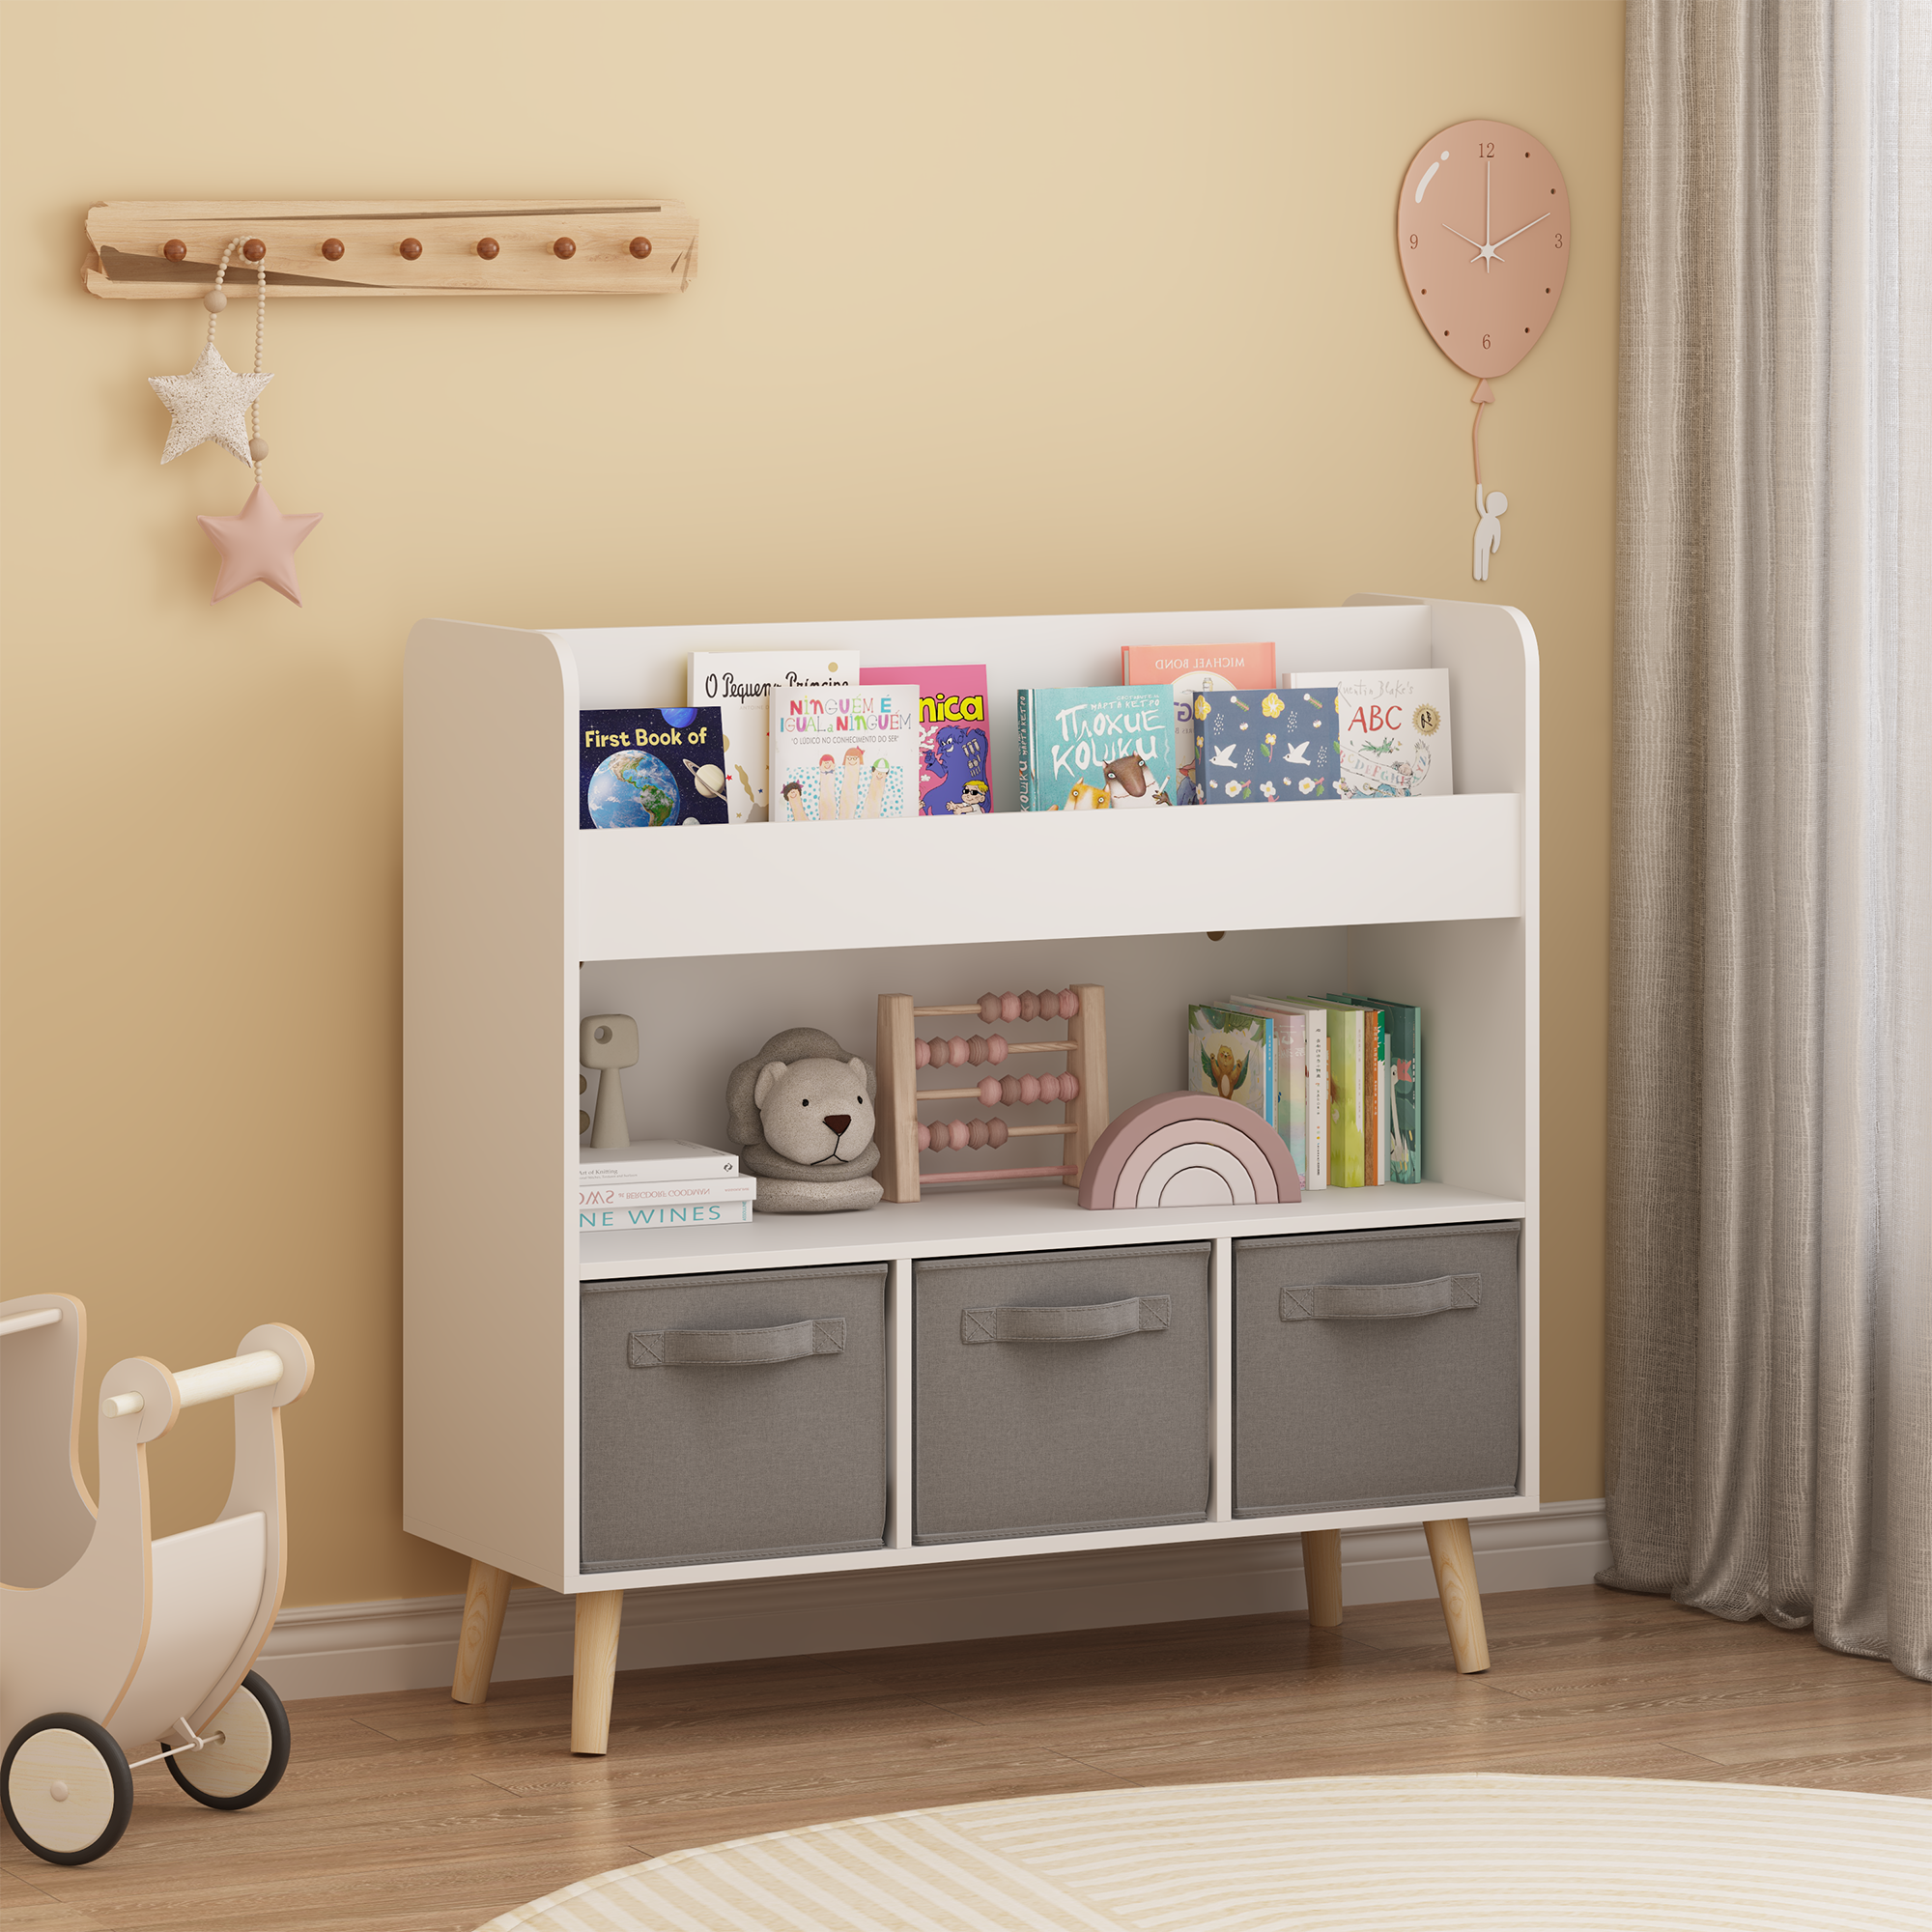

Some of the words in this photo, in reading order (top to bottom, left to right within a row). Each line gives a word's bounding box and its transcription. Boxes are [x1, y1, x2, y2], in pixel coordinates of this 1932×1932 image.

[1478, 142, 1495, 158] 12
[1409, 233, 1419, 249] 9
[1554, 233, 1563, 249] 3
[1482, 333, 1492, 350] 6
[705, 673, 718, 698] O
[722, 672, 781, 704] Pequen
[880, 694, 892, 713] É
[1091, 700, 1122, 711] МАРТА
[1125, 698, 1160, 709] КЕТРО
[781, 716, 826, 732] IGUAL
[1348, 705, 1403, 733] ABC
[584, 730, 631, 748] First
[635, 727, 683, 747] Book
[687, 726, 708, 745] of
[822, 735, 831, 744] NO
[628, 1206, 721, 1224] WINES
